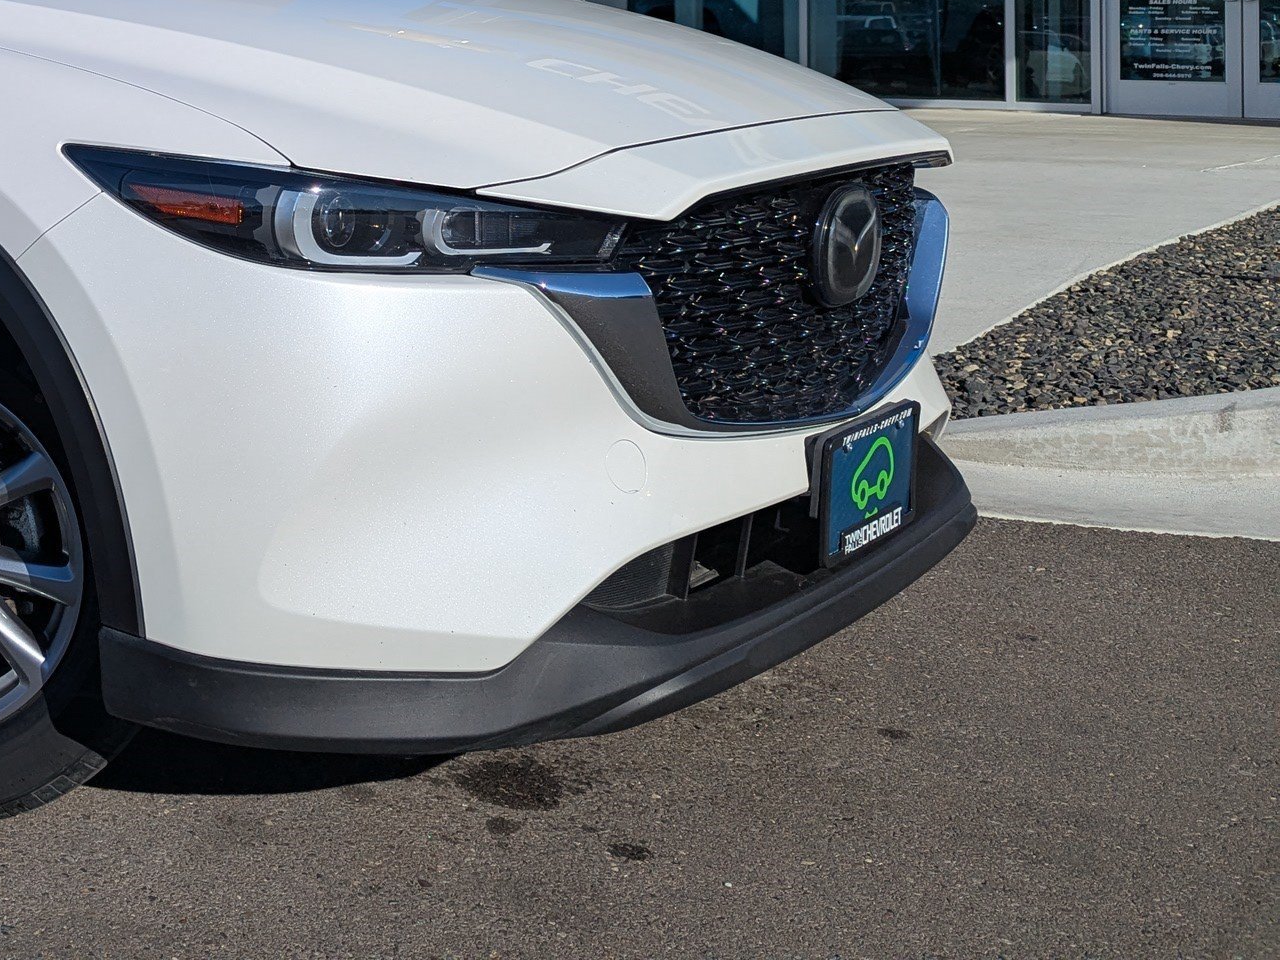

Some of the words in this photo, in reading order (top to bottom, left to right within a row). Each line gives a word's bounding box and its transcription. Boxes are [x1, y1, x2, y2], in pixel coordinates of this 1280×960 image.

[861, 506, 902, 545] CHEVROLET
[844, 537, 863, 555] FALLS
[845, 528, 863, 546] TWIN
